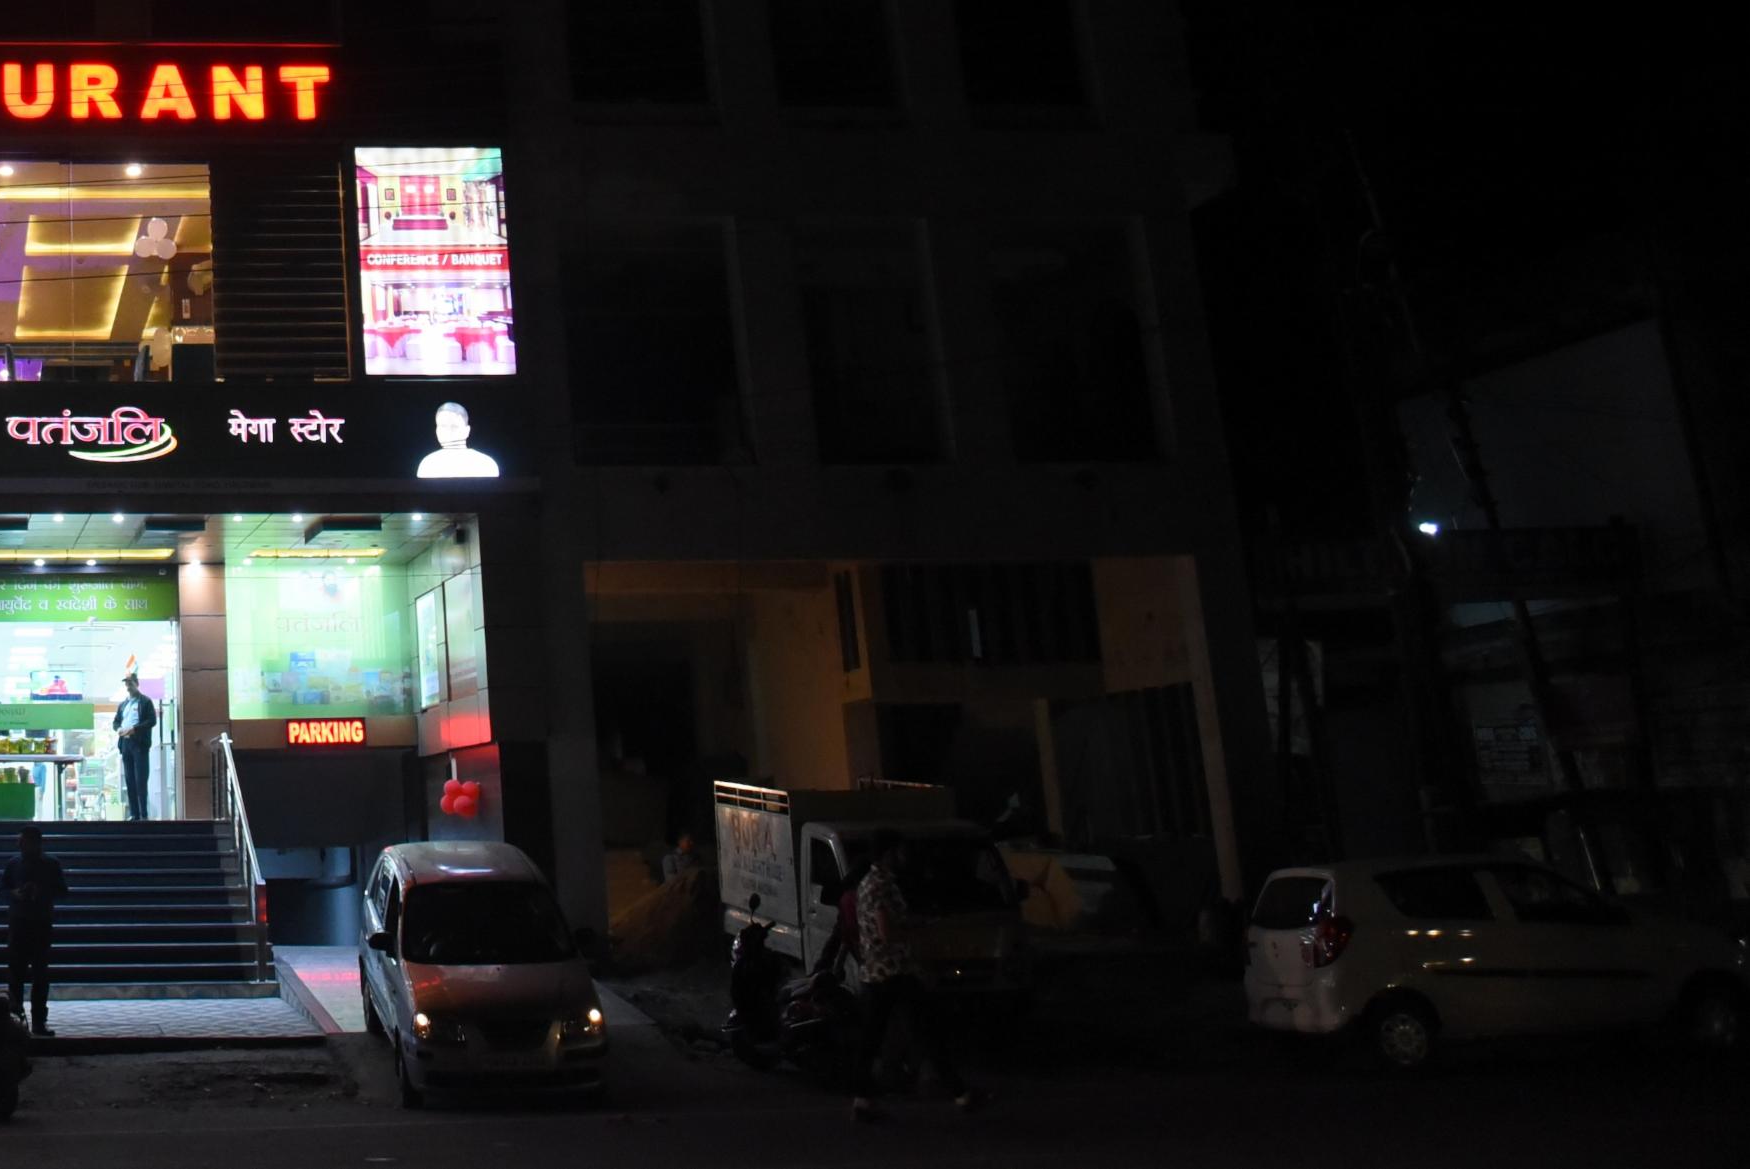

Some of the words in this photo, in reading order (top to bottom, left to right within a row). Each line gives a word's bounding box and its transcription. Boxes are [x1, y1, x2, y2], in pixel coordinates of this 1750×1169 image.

[366, 252, 440, 266] CONFERENCE
[451, 252, 504, 266] BANQUET
[5, 405, 168, 446] पतंजलि
[228, 408, 276, 444] मेगा
[290, 409, 346, 444] स्टोर
[104, 596, 118, 611] के
[288, 721, 365, 744] PARKING
